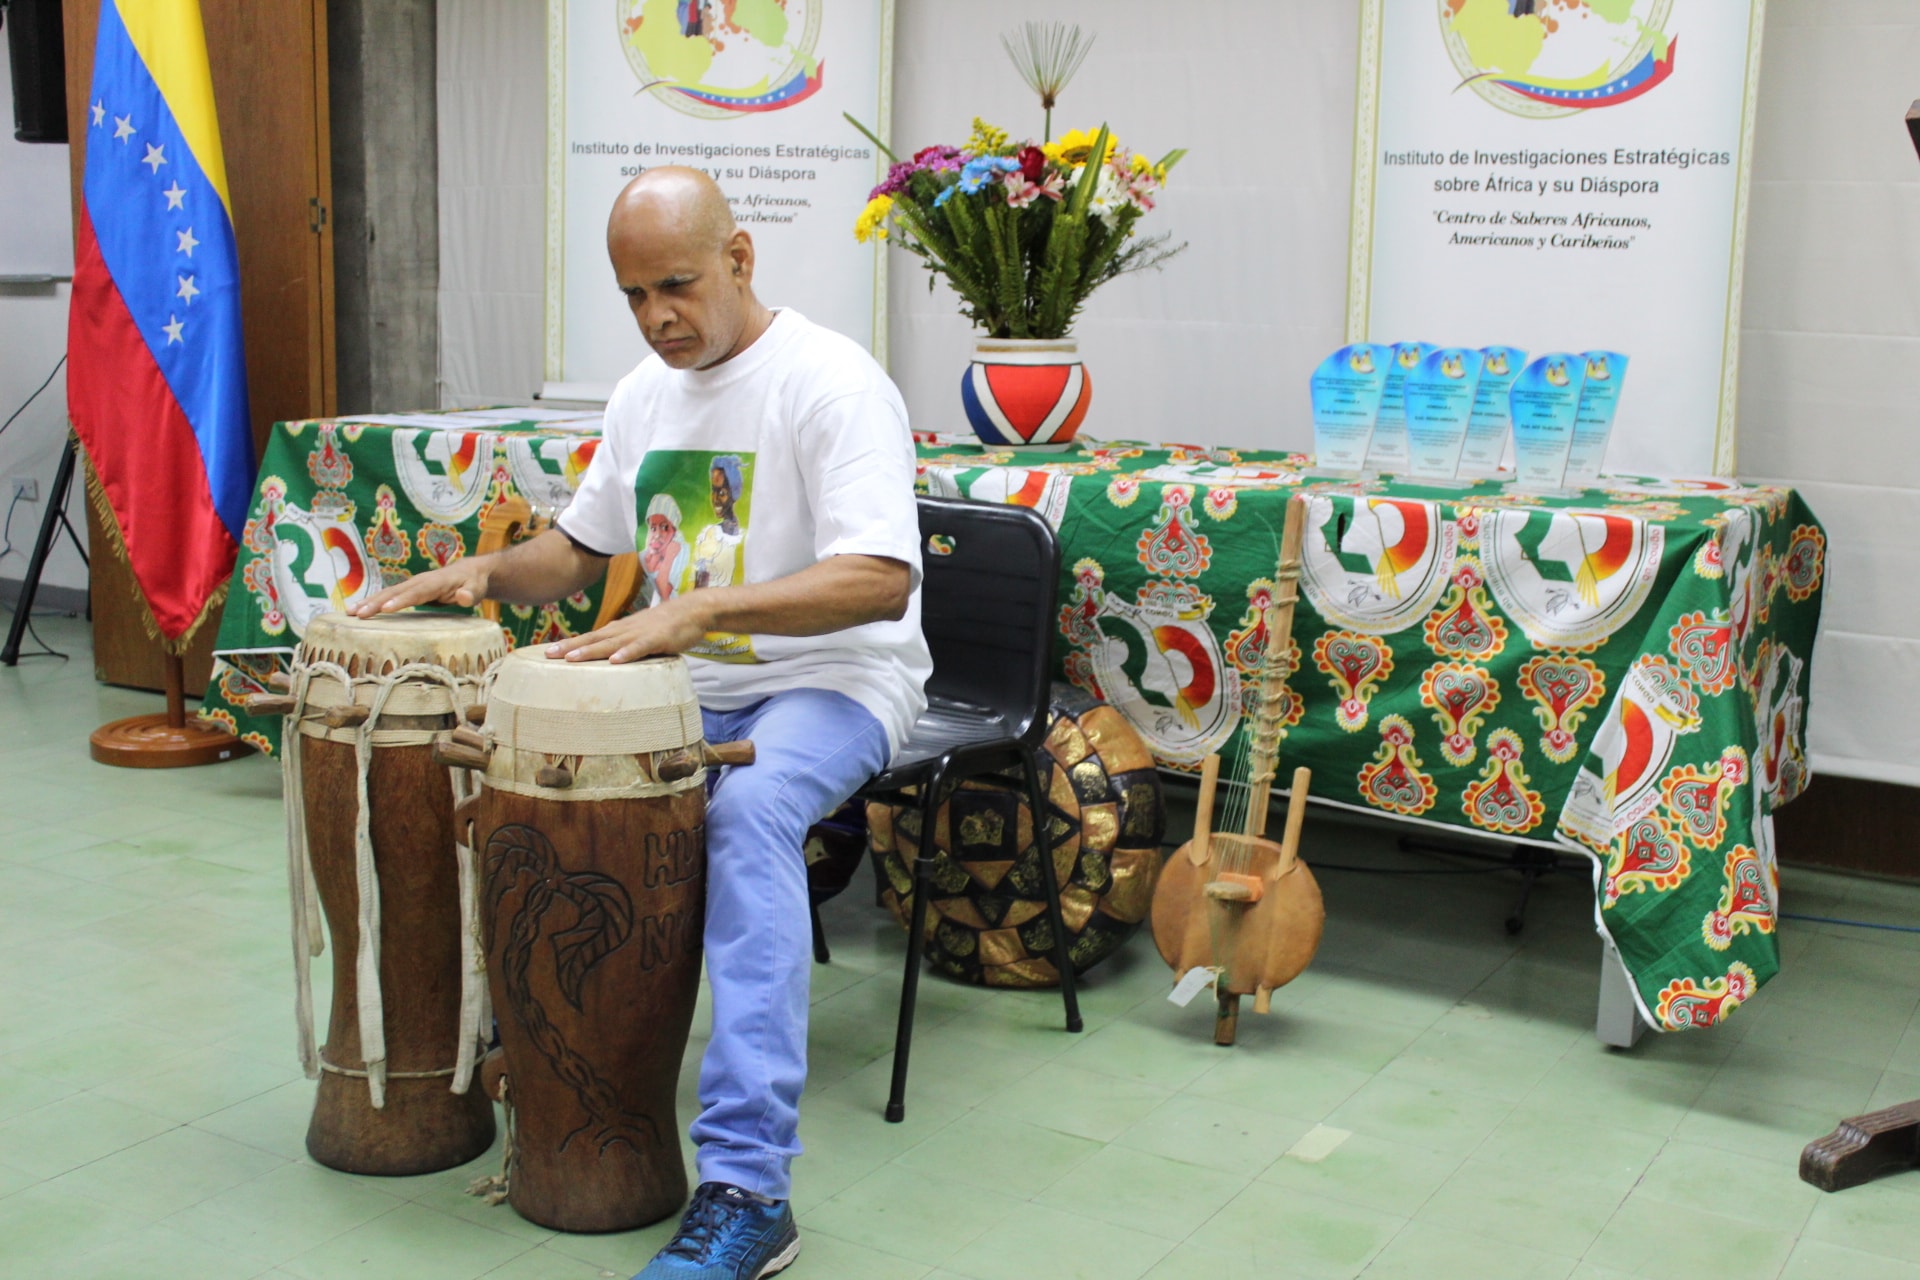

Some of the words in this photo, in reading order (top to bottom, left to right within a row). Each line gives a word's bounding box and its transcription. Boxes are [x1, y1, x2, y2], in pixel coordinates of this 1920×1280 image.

[572, 141, 629, 155] Instituto
[633, 142, 652, 155] de
[656, 142, 771, 159] Investigaciones
[775, 143, 870, 161] Estratégicas
[1384, 150, 1445, 165] Instituto
[1449, 150, 1469, 165] de
[1474, 149, 1607, 169] Investigaciones
[1613, 147, 1731, 169] Estratégicas
[712, 169, 722, 182] y
[726, 167, 744, 179] su
[749, 165, 816, 183] Diáspora
[1434, 177, 1480, 192] sobre
[1485, 172, 1533, 192] África
[1538, 180, 1547, 196] y
[1553, 180, 1574, 193] su
[1580, 176, 1659, 197] Diáspora
[743, 194, 811, 208] Africanos,
[733, 211, 798, 224] aribeños"
[1433, 210, 1487, 225] "Centro
[1489, 211, 1507, 225] de
[1510, 211, 1568, 226] Saberes
[1571, 212, 1651, 230] Africanos,
[1448, 232, 1535, 247] Americanos
[1537, 237, 1547, 250] y
[1550, 233, 1635, 250] Caribeños"
